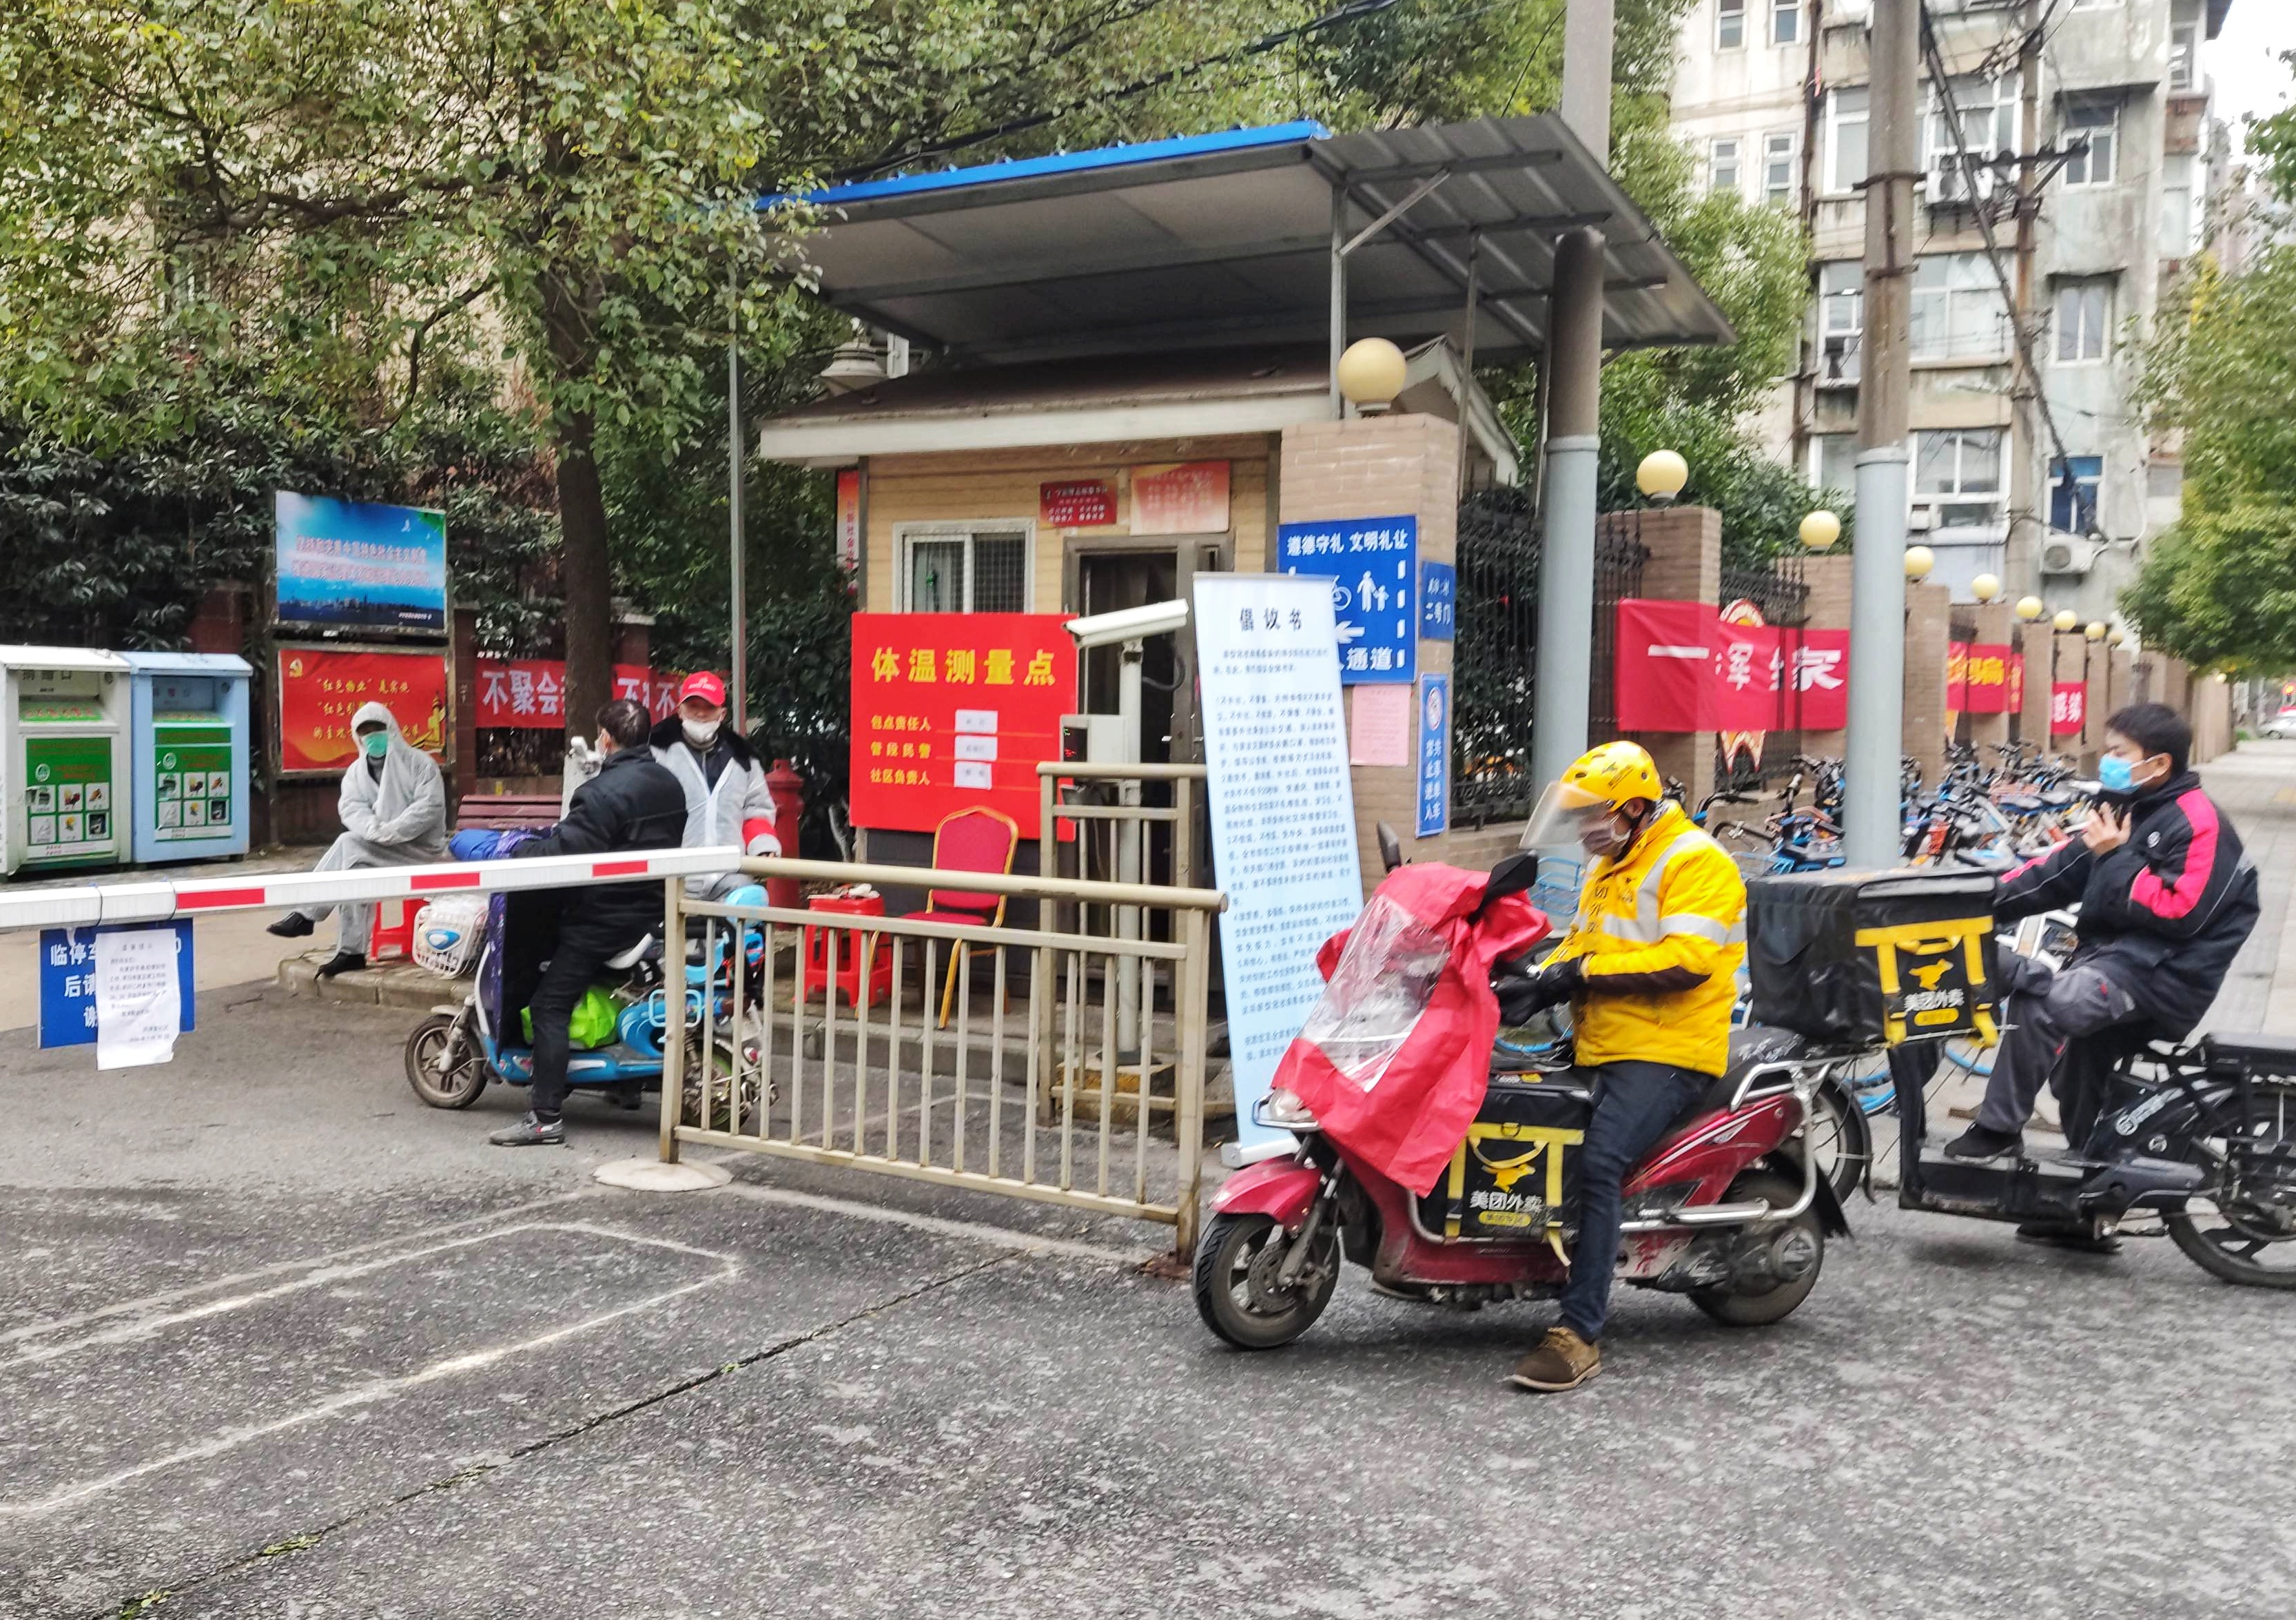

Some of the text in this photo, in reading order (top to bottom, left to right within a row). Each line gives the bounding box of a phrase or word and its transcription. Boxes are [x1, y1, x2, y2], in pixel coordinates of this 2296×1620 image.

[1239, 607, 1302, 632] 倡议书
[872, 647, 1056, 686] 体温测量点
[1339, 646, 1393, 671] 通道
[482, 669, 566, 715] 不聚会
[1470, 1190, 1544, 1212] 美团外卖
